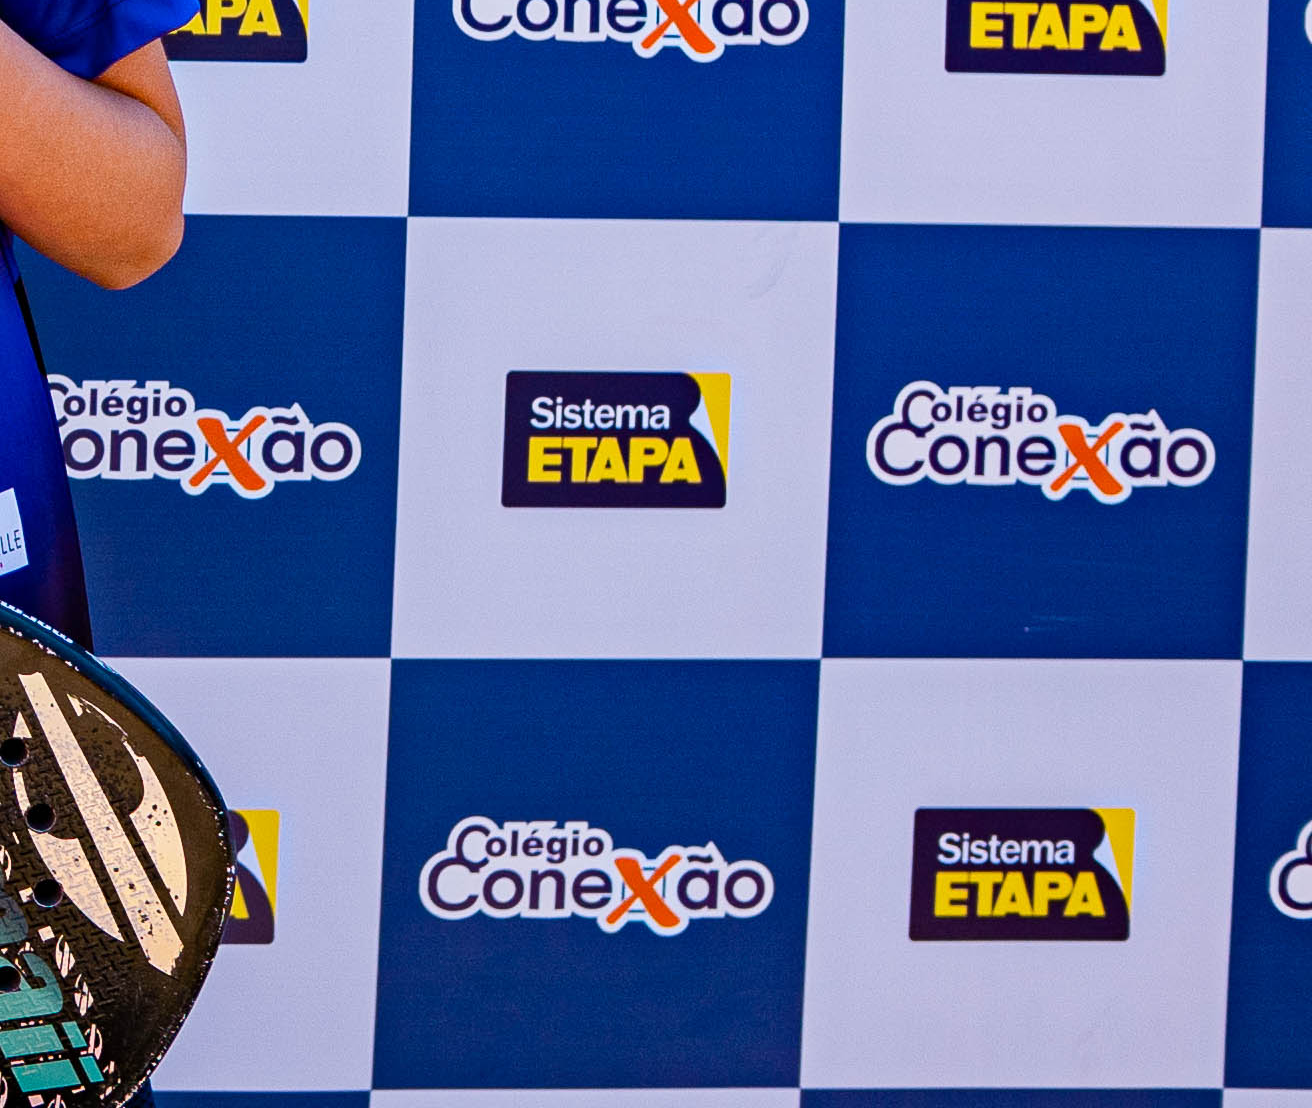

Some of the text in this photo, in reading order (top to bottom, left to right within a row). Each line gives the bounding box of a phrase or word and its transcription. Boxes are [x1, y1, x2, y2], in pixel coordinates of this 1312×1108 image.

[969, 2, 1141, 52] ETAPA
[531, 396, 670, 432] Sistema
[902, 388, 1048, 430] Colégio
[63, 414, 352, 492] oneXão
[527, 436, 702, 484] ETAPA
[457, 825, 605, 868] Colégio
[937, 832, 1075, 868] Sistema
[934, 871, 1106, 919] ETAPA
